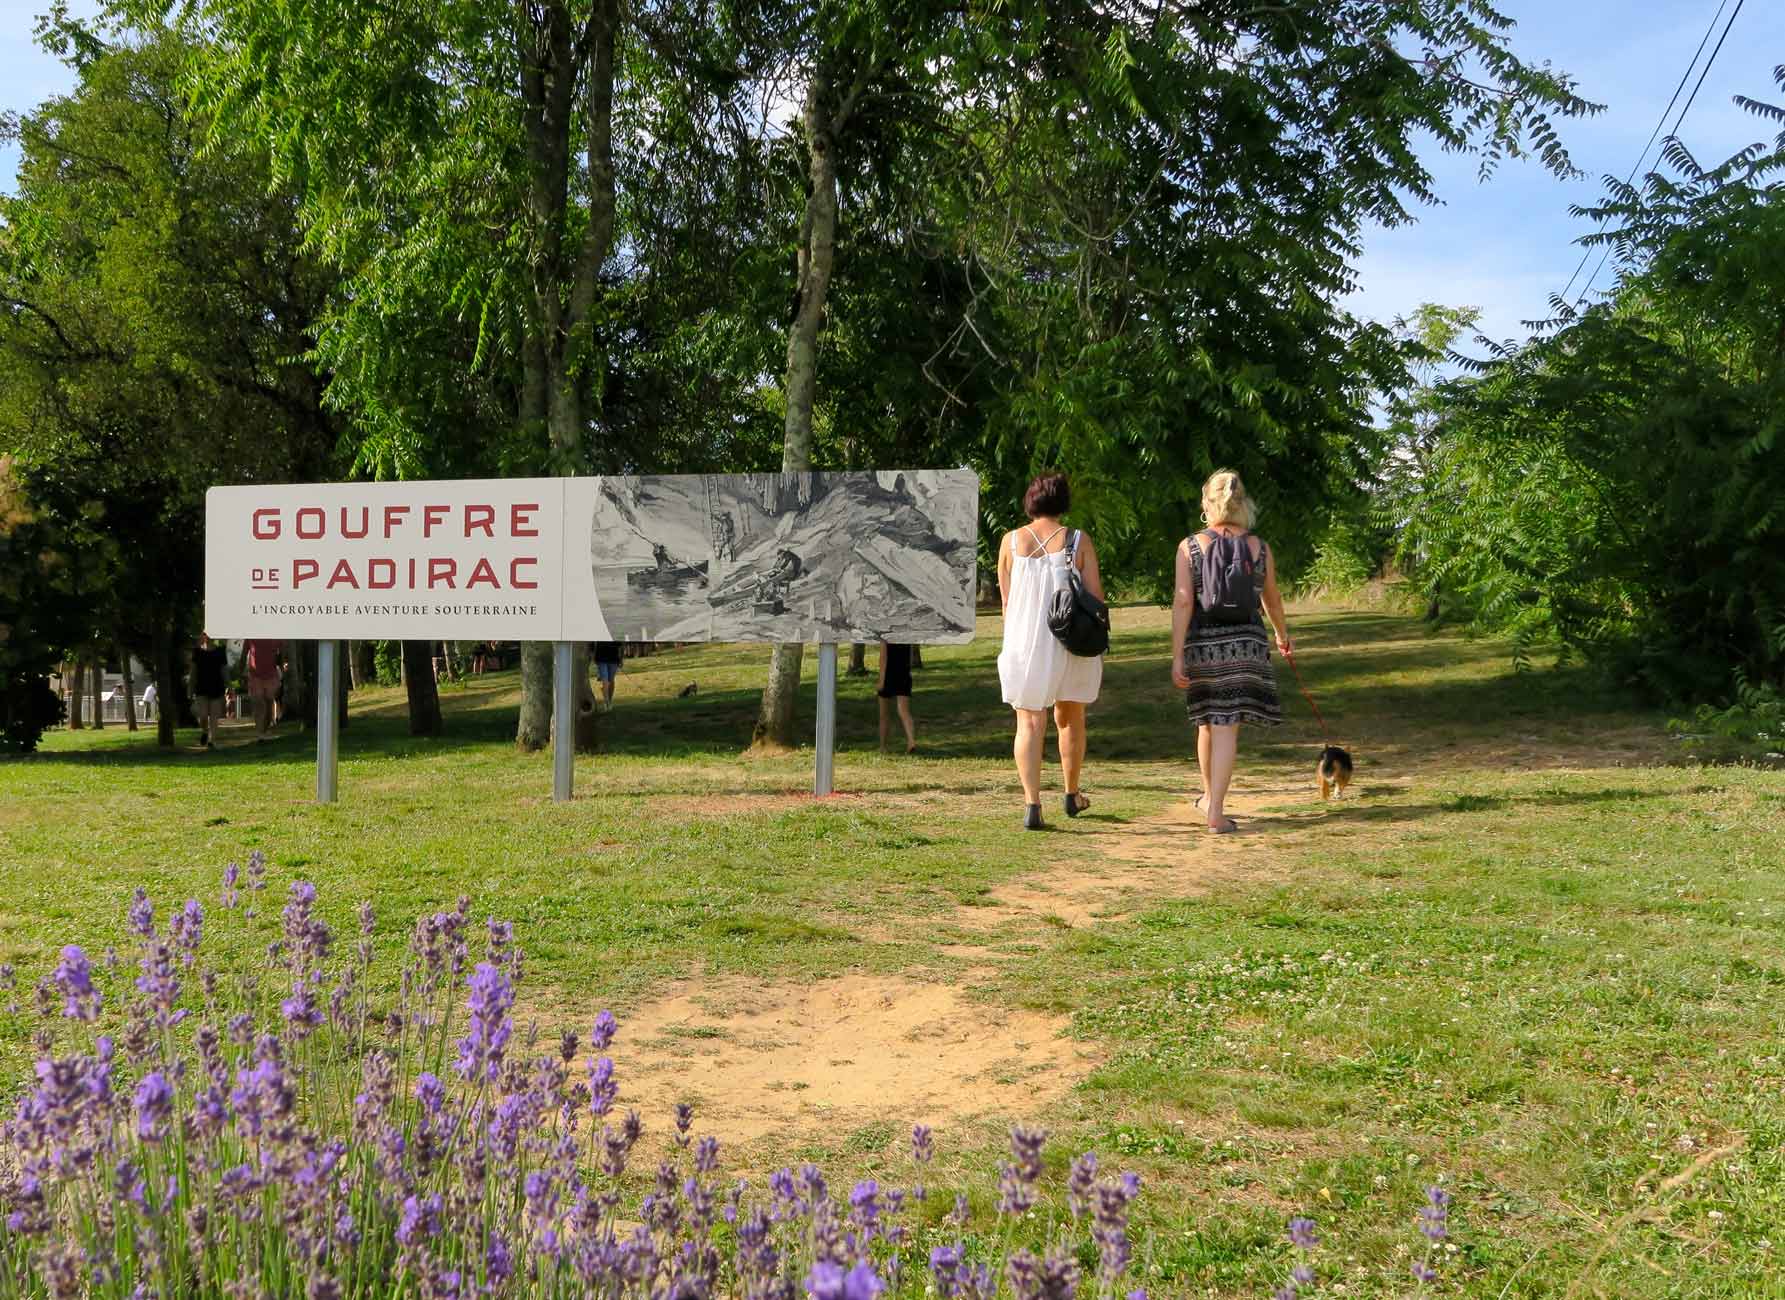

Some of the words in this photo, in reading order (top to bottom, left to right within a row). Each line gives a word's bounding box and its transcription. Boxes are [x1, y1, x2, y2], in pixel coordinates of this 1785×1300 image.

[252, 504, 540, 541] GOUFFRE
[251, 568, 280, 582] DE
[292, 557, 540, 590] PADIRAC
[252, 605, 350, 615] L'INCROYABLE
[354, 605, 428, 615] AVENTURE
[434, 605, 537, 616] SOUTERRAINE
